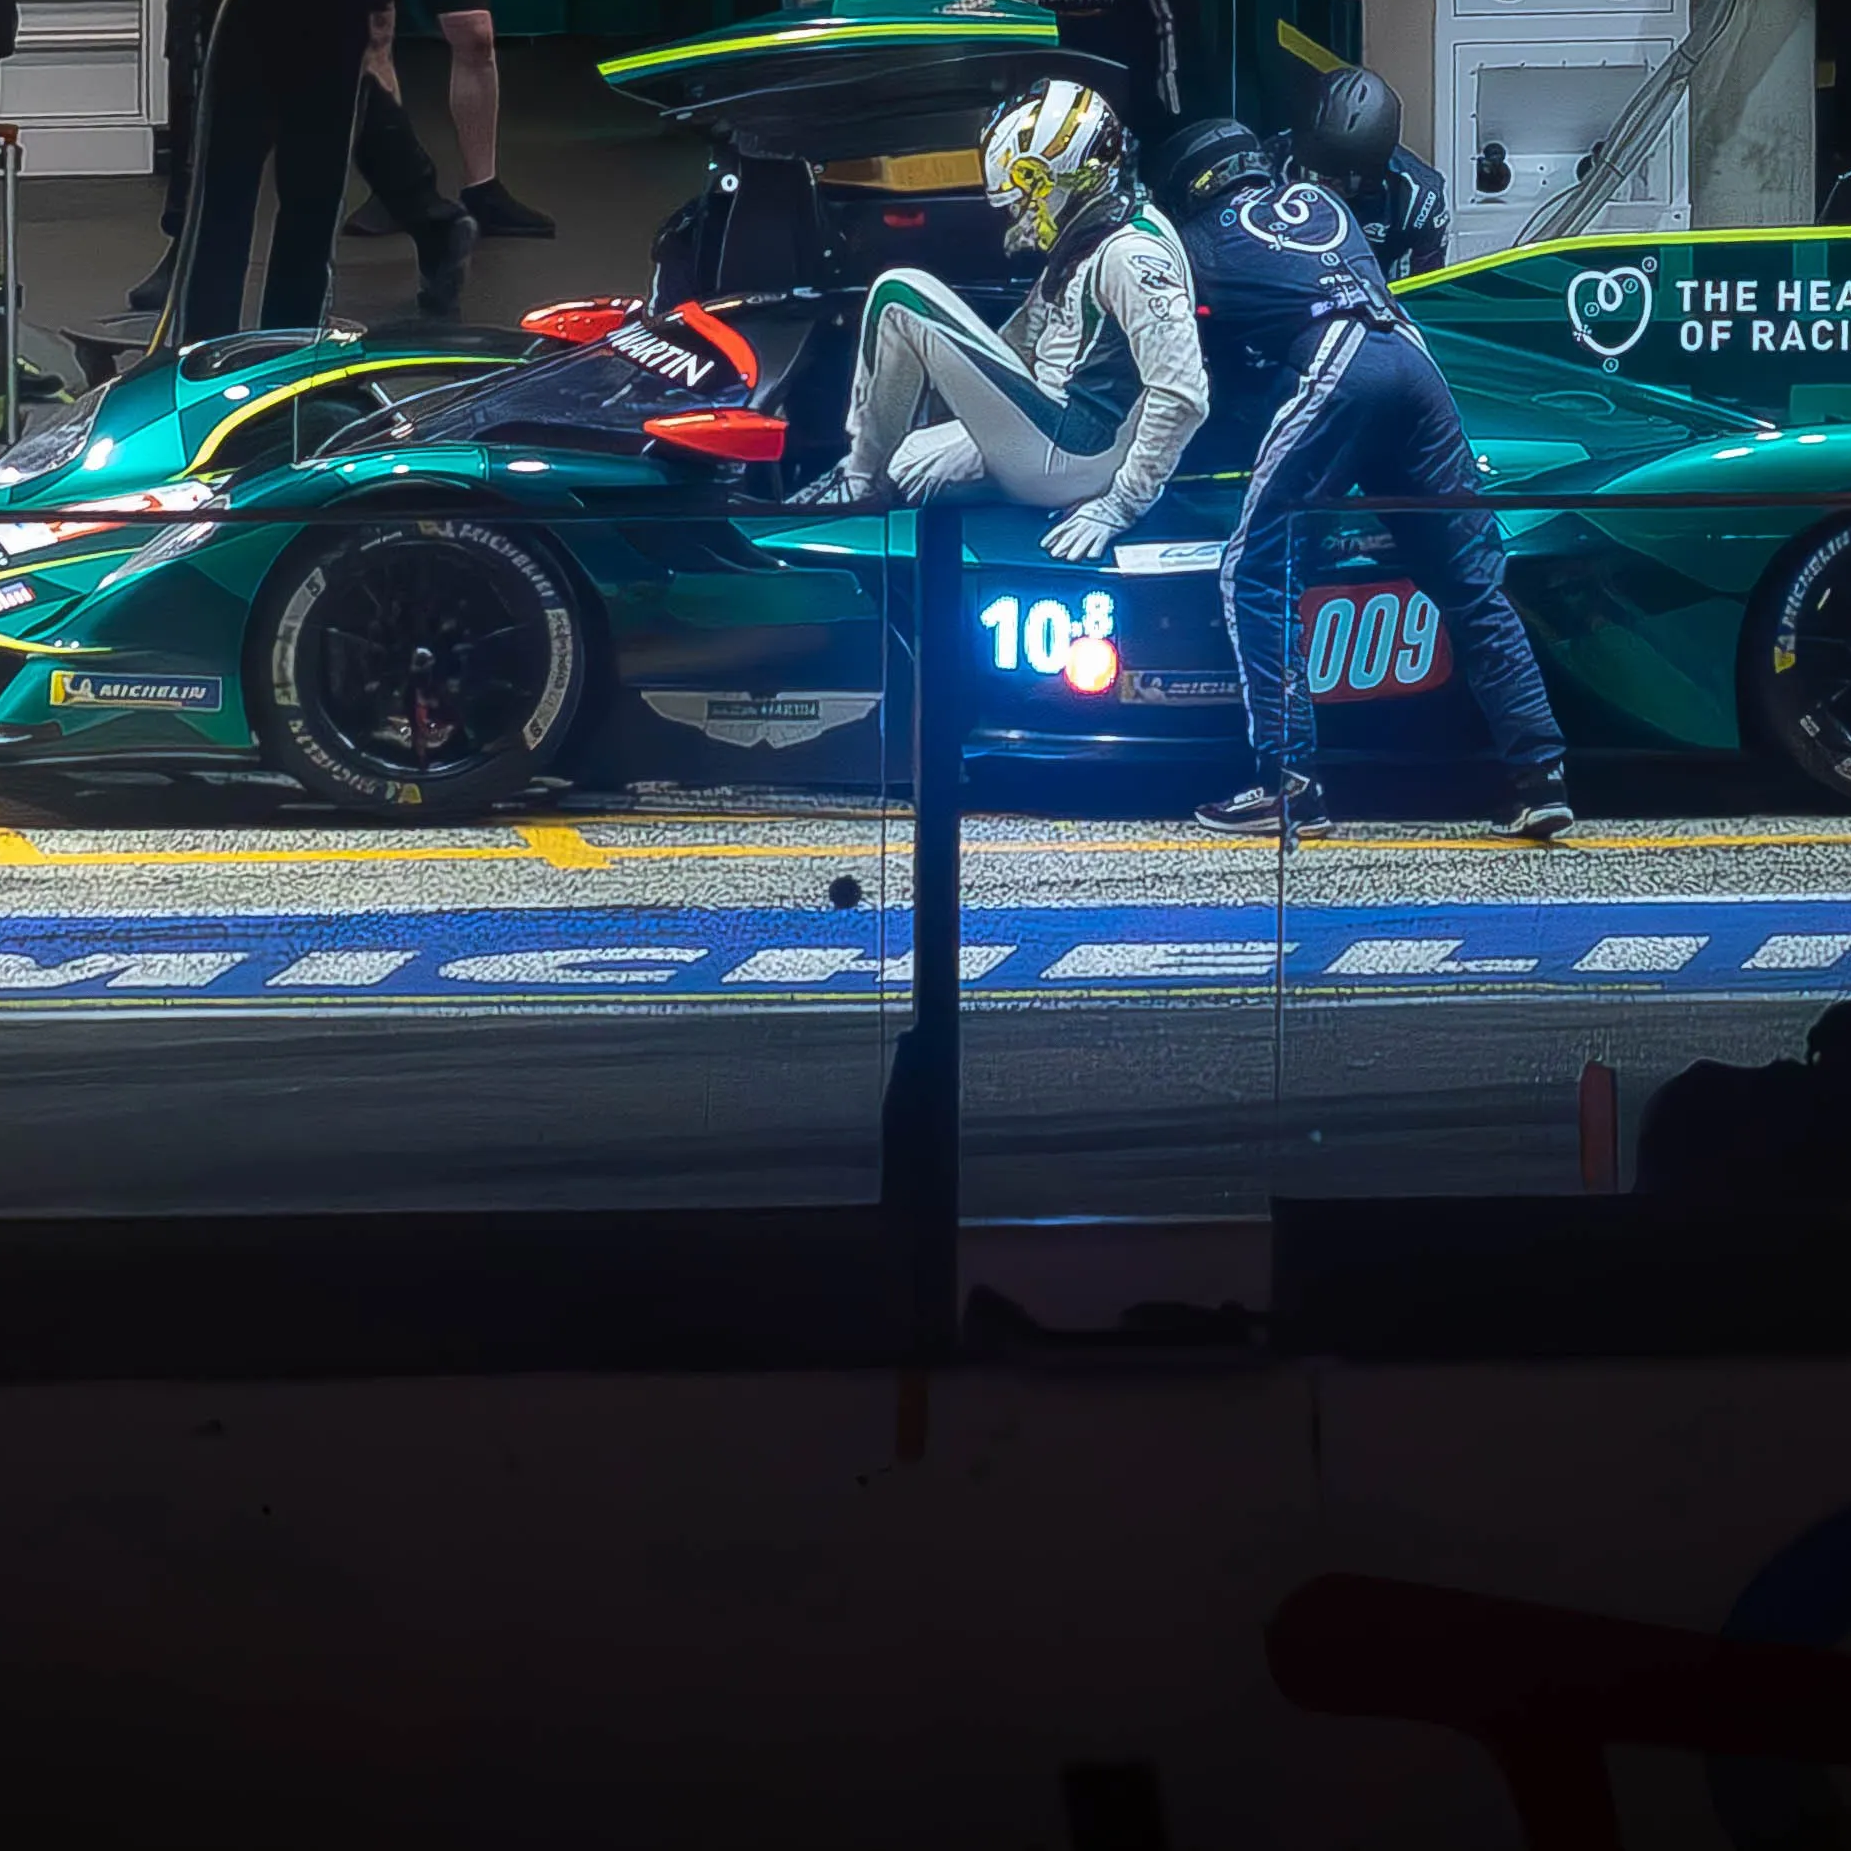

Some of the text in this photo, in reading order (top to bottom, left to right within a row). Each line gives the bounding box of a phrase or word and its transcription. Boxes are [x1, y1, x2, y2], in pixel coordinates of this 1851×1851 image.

[1675, 280, 1758, 312] THE
[611, 324, 715, 387] MARTIN
[1680, 319, 1734, 352] OF
[1781, 530, 1851, 628] MICHELIN
[1307, 590, 1441, 694] 009
[99, 683, 208, 700] MICHELIN
